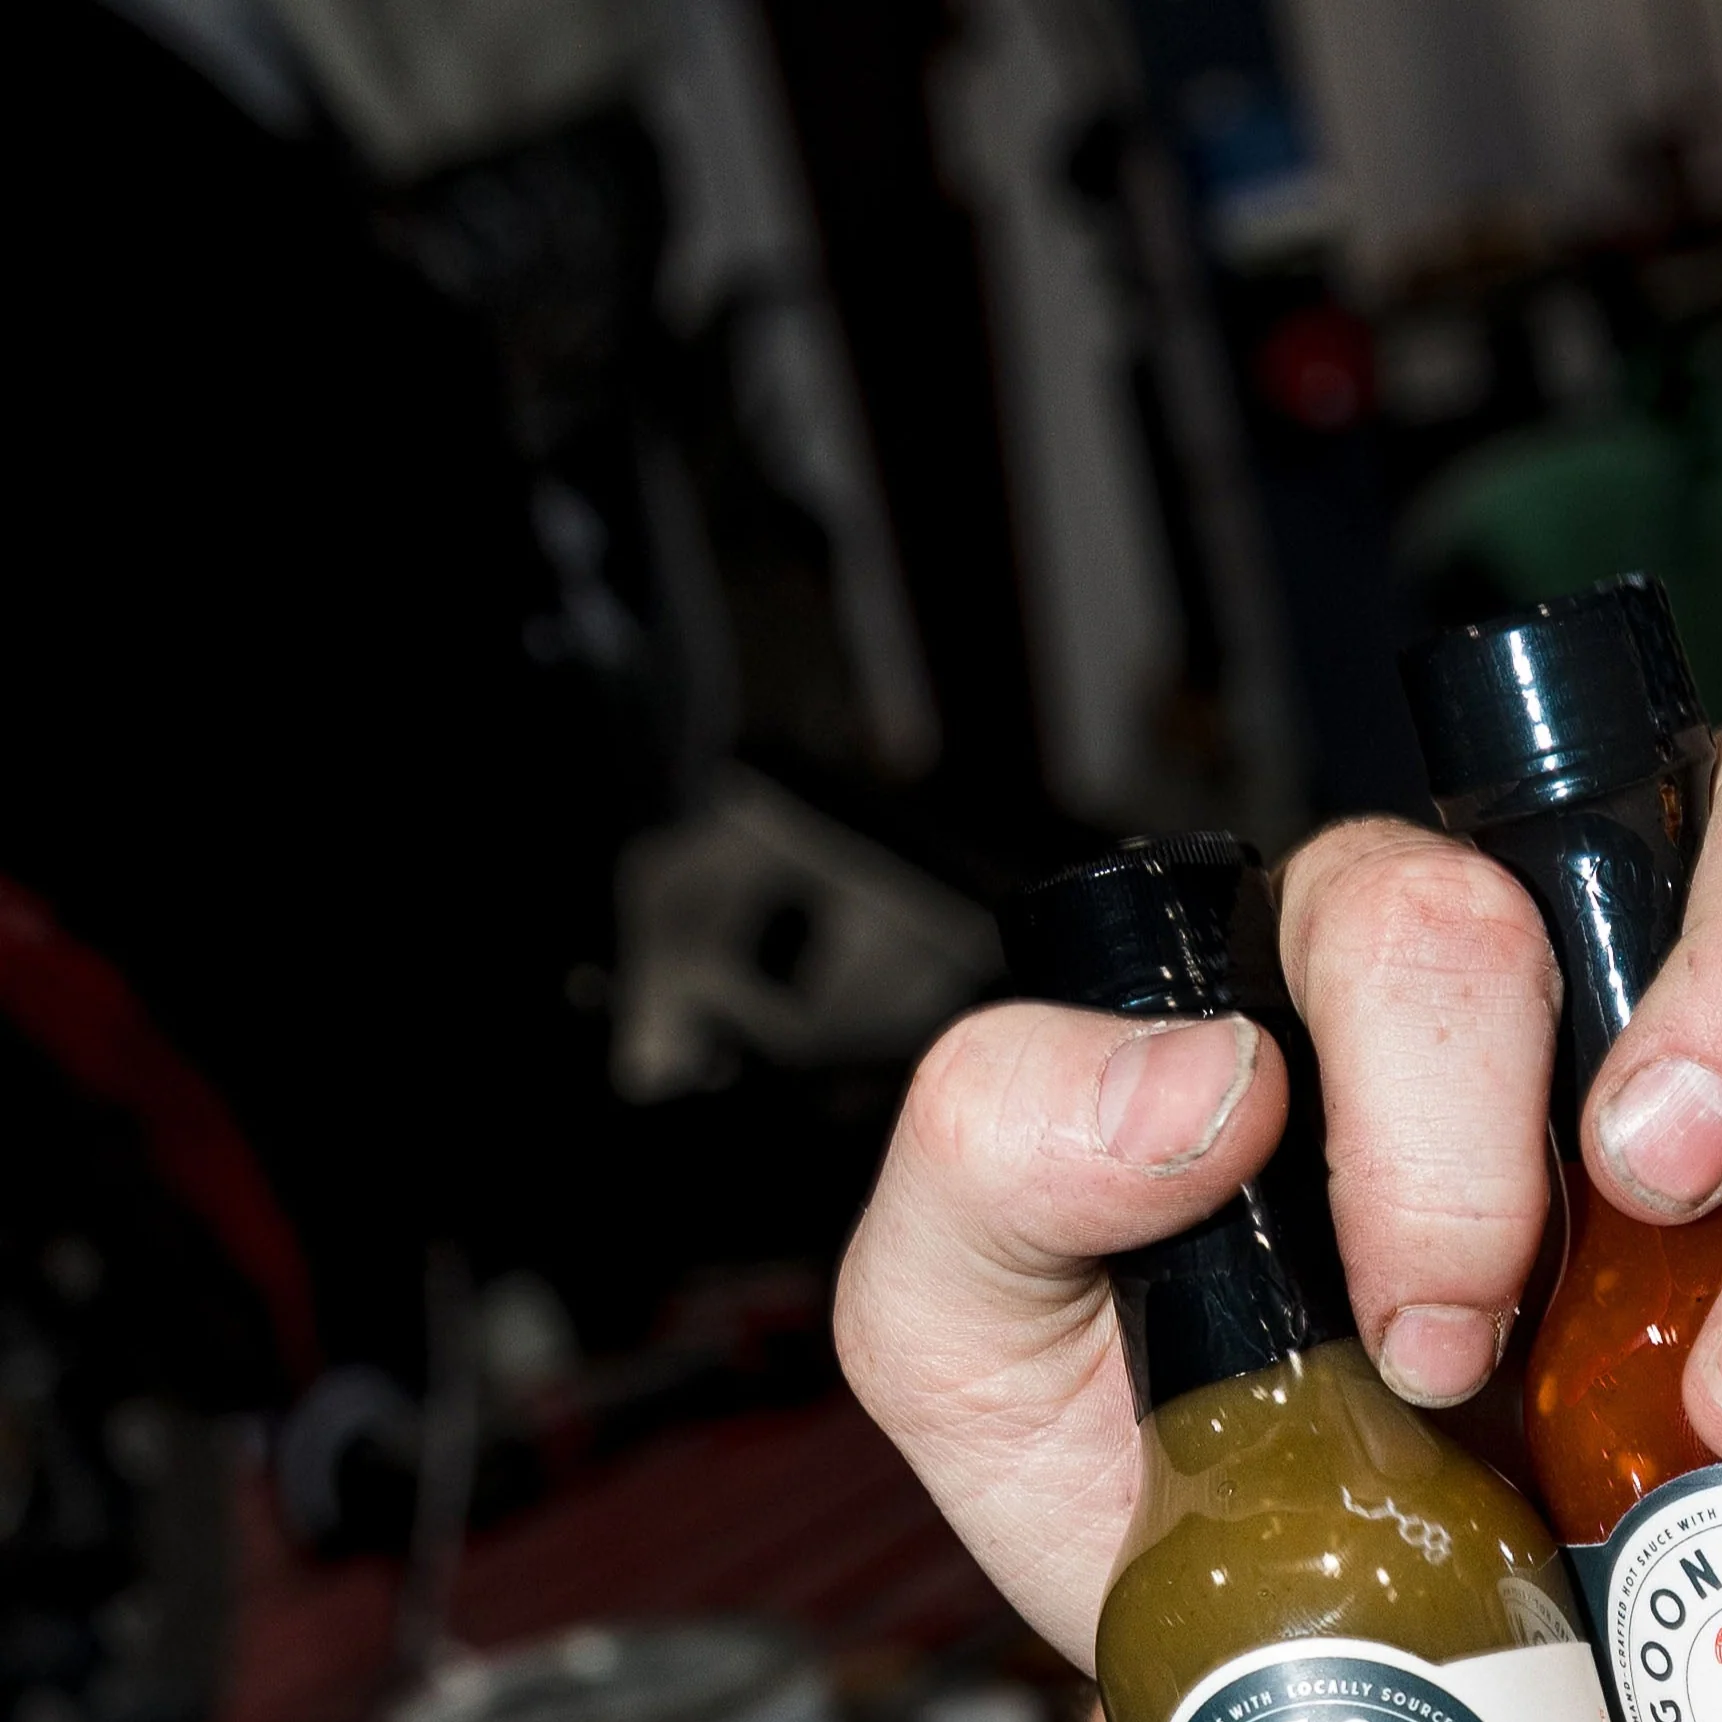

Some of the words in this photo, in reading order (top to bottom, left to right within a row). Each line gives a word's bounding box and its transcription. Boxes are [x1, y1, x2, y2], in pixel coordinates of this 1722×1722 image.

[1622, 1568, 1639, 1597] HOT
[1637, 1528, 1674, 1567] SAUCE
[1677, 1507, 1717, 1531] WITH
[1229, 1690, 1273, 1720] WITH
[1286, 1679, 1373, 1699] LOCALLY
